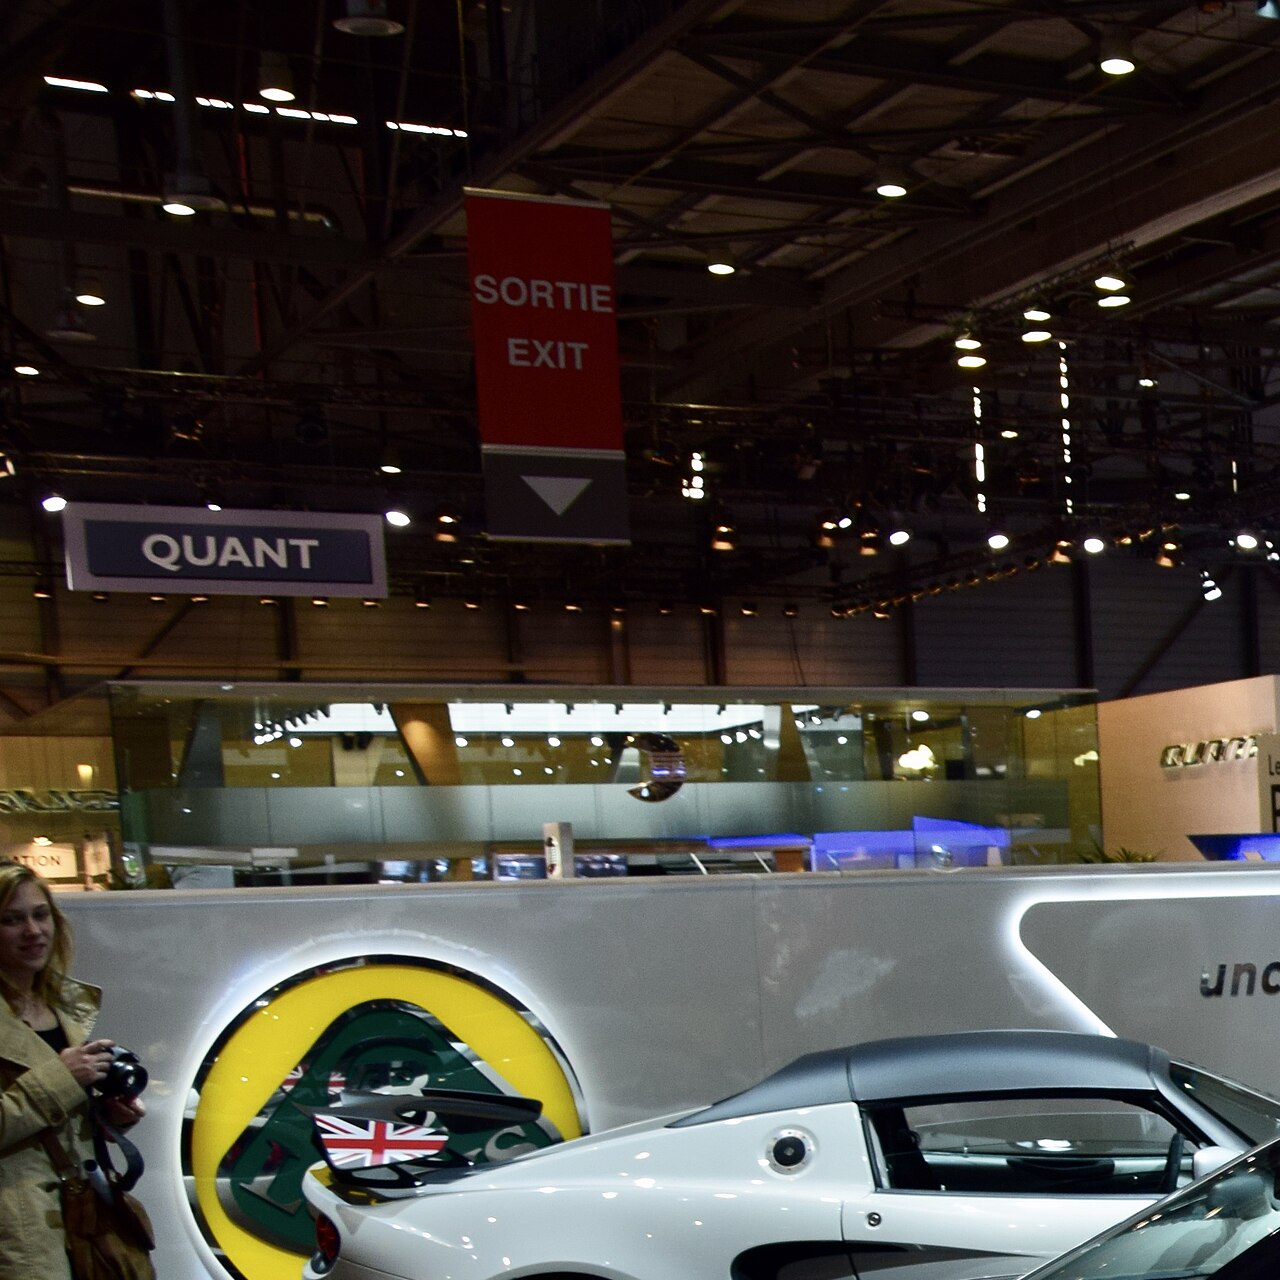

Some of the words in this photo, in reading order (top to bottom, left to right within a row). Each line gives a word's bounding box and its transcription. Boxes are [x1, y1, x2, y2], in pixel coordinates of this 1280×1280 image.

[473, 273, 615, 314] SORTIE
[507, 337, 590, 371] EXIT
[142, 533, 321, 573] QUANT
